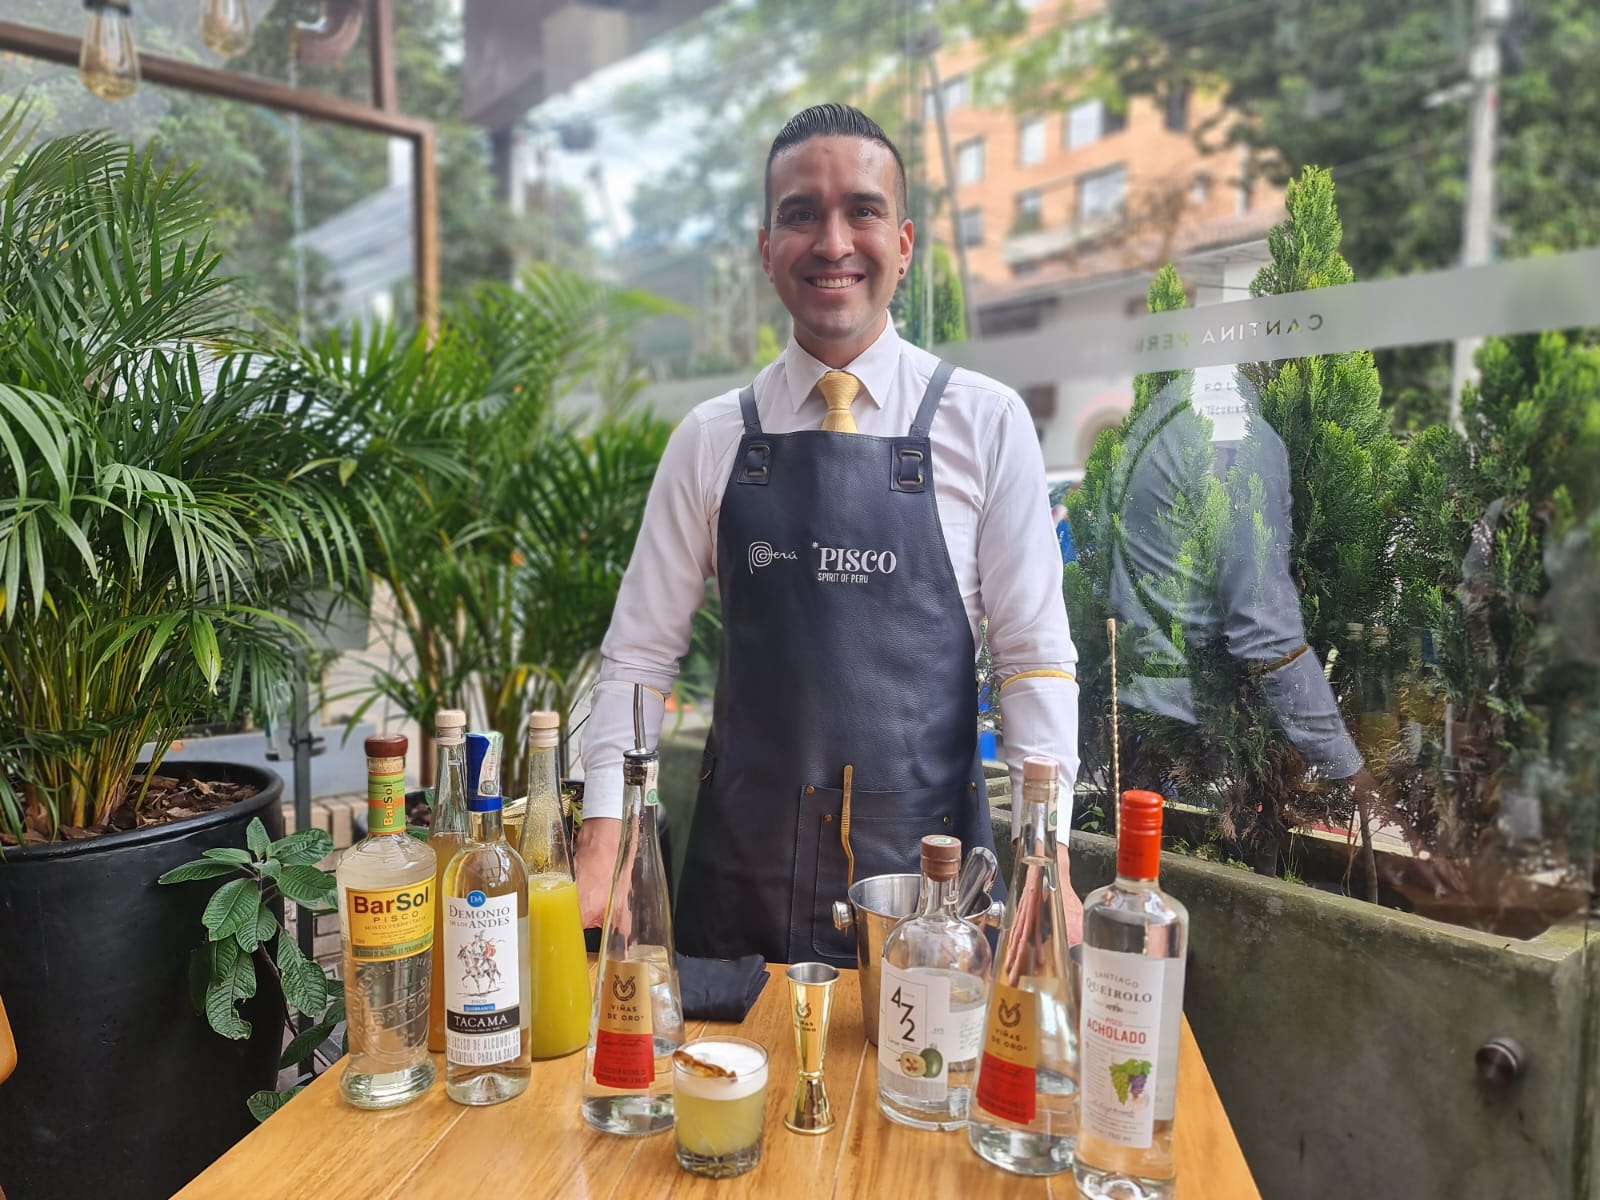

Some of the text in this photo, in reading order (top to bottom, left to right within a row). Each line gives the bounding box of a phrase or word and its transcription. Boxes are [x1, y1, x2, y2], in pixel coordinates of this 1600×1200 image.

[817, 547, 897, 574] PISCO
[817, 572, 869, 584] SPIRIT OF PERU
[383, 784, 394, 826] BarSol
[353, 885, 429, 915] BarSol
[470, 895, 483, 904] DA
[373, 910, 419, 924] PISCO
[449, 905, 510, 920] DEMONIO
[468, 917, 510, 929] ANDES
[1094, 970, 1139, 989] SANTIAGO
[1086, 977, 1153, 1003] QUEIROLO
[607, 1012, 618, 1020] DE
[611, 1004, 638, 1013] VIÑAS
[453, 1013, 509, 1028] TACAMA
[1087, 1017, 1147, 1045] ACHOLADO
